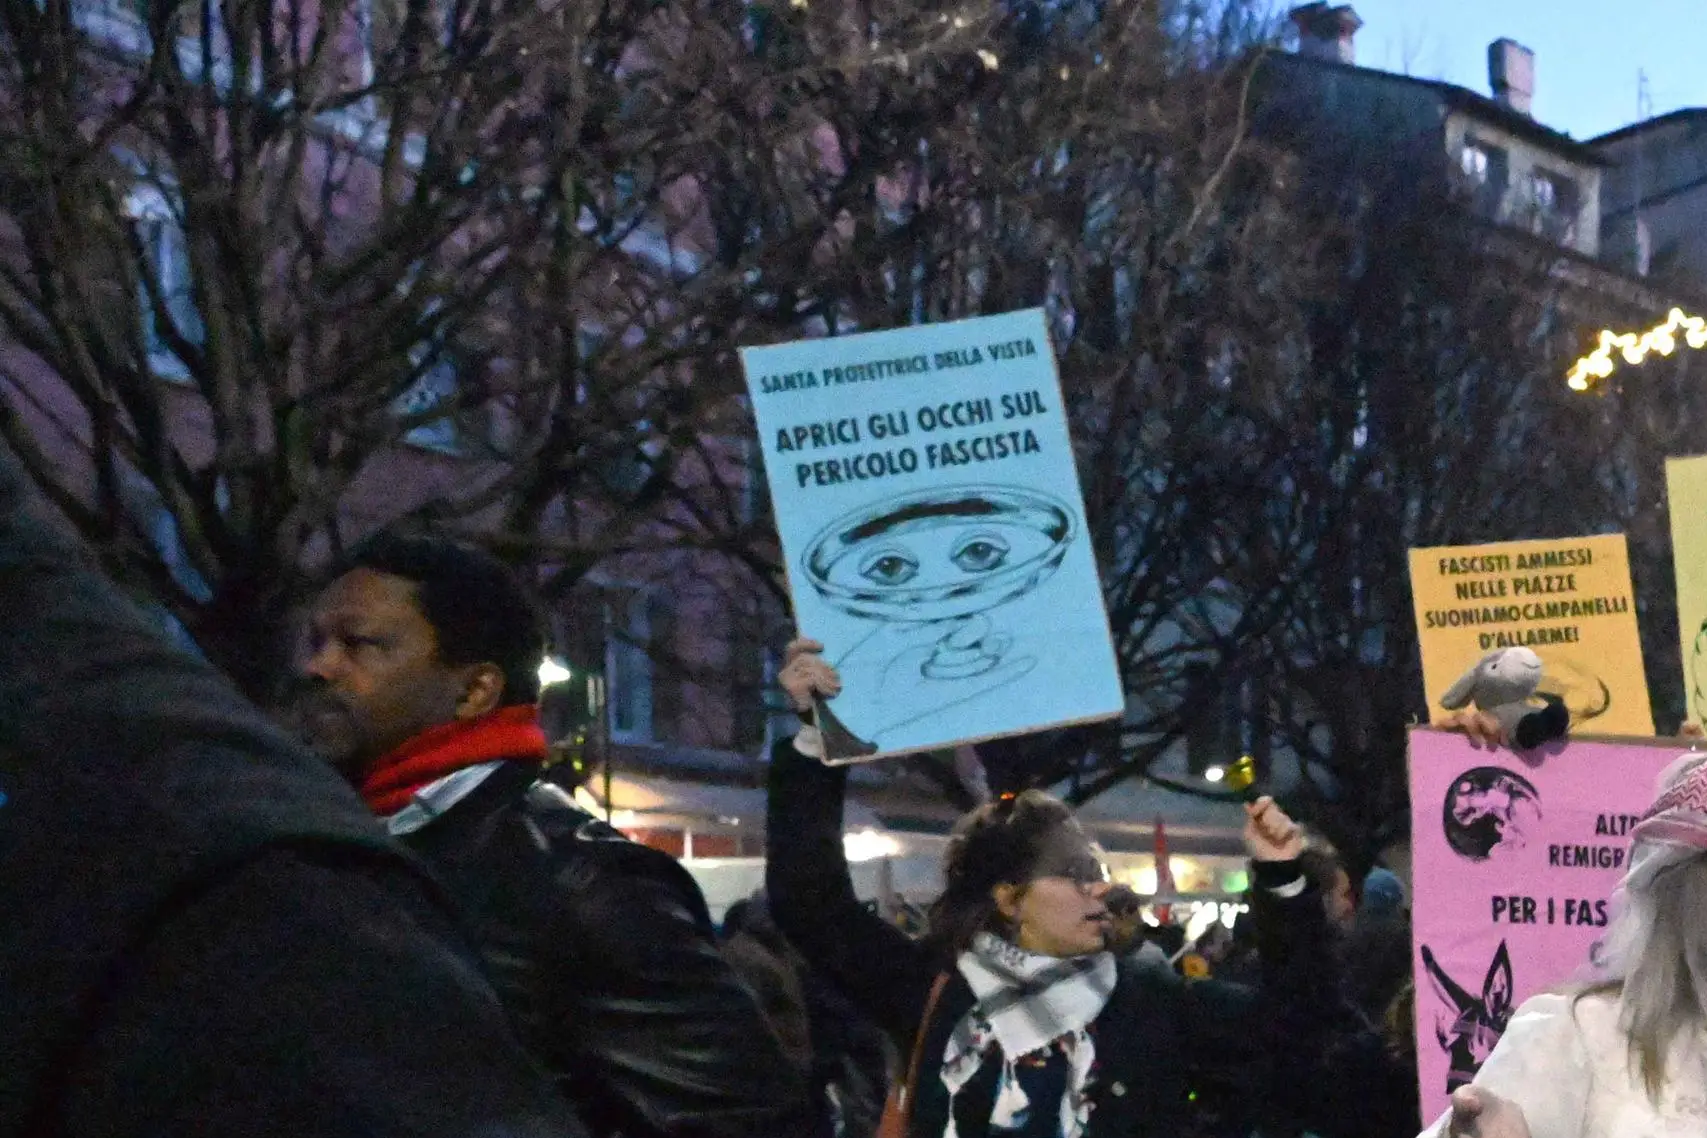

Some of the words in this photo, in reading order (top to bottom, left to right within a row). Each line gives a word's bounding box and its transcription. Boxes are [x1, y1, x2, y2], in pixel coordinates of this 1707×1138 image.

[760, 370, 818, 394] SANTA
[823, 353, 929, 386] PROTETTRICE
[934, 348, 983, 369] DELLA
[988, 337, 1036, 361] VISTA
[775, 417, 860, 453] APRICI
[868, 409, 908, 439] GLI
[917, 397, 993, 431] OCCHI
[1002, 390, 1047, 418] SUL
[796, 447, 918, 488] PERICOLO
[928, 429, 1041, 469] FASCISTA
[1439, 555, 1510, 575] FASCISTI
[1516, 548, 1592, 570] AMMESSI
[1456, 580, 1506, 600] NELLE
[1513, 573, 1576, 596] PIAZZE
[1424, 606, 1521, 628] SUONIAMO
[1522, 596, 1628, 620] CAMPANELLI
[1478, 626, 1579, 649] D'ALLARME!
[1549, 844, 1625, 868] REMIGR
[1491, 895, 1537, 925] PER
[1547, 897, 1555, 924] I
[1563, 898, 1608, 927] FAS
